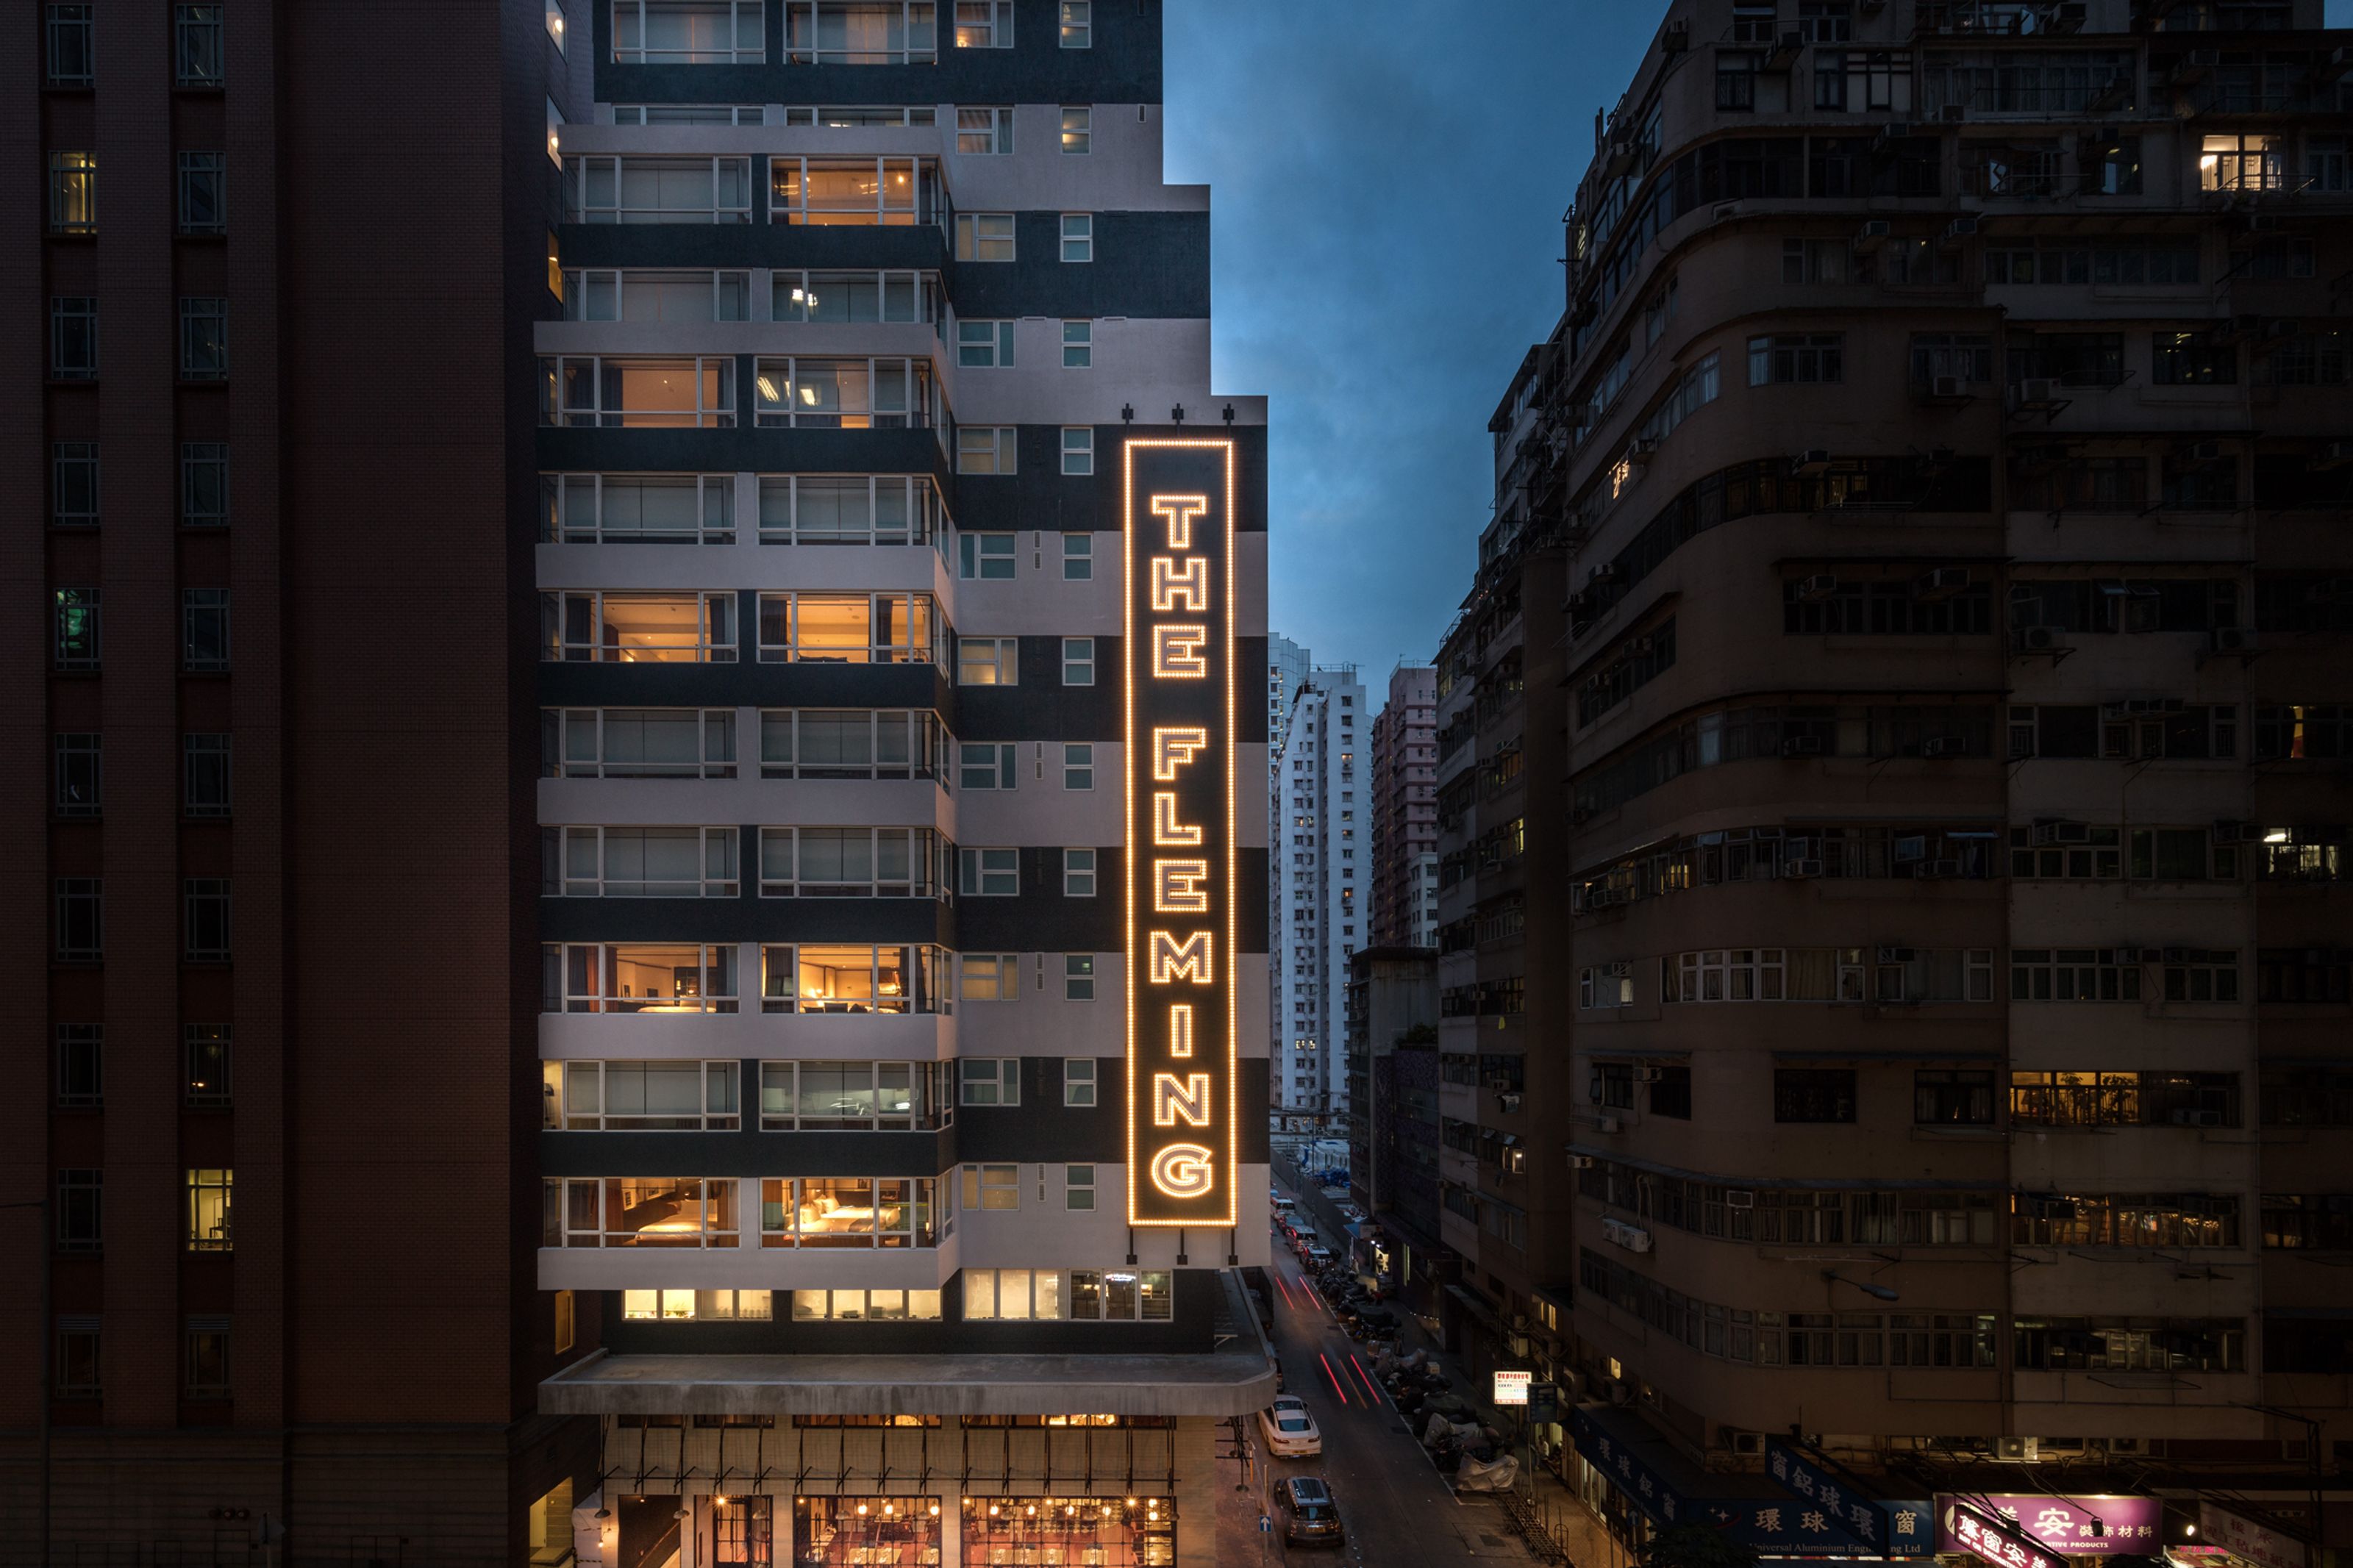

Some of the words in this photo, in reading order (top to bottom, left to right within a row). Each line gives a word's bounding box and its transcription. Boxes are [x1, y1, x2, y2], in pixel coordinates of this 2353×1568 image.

[1151, 494, 1207, 679] THE
[1149, 726, 1213, 1200] FLEMING
[1754, 1507, 1918, 1536] 環球窗
[1794, 1542, 1846, 1553] Aluminium
[1904, 1544, 1921, 1553] Ltd
